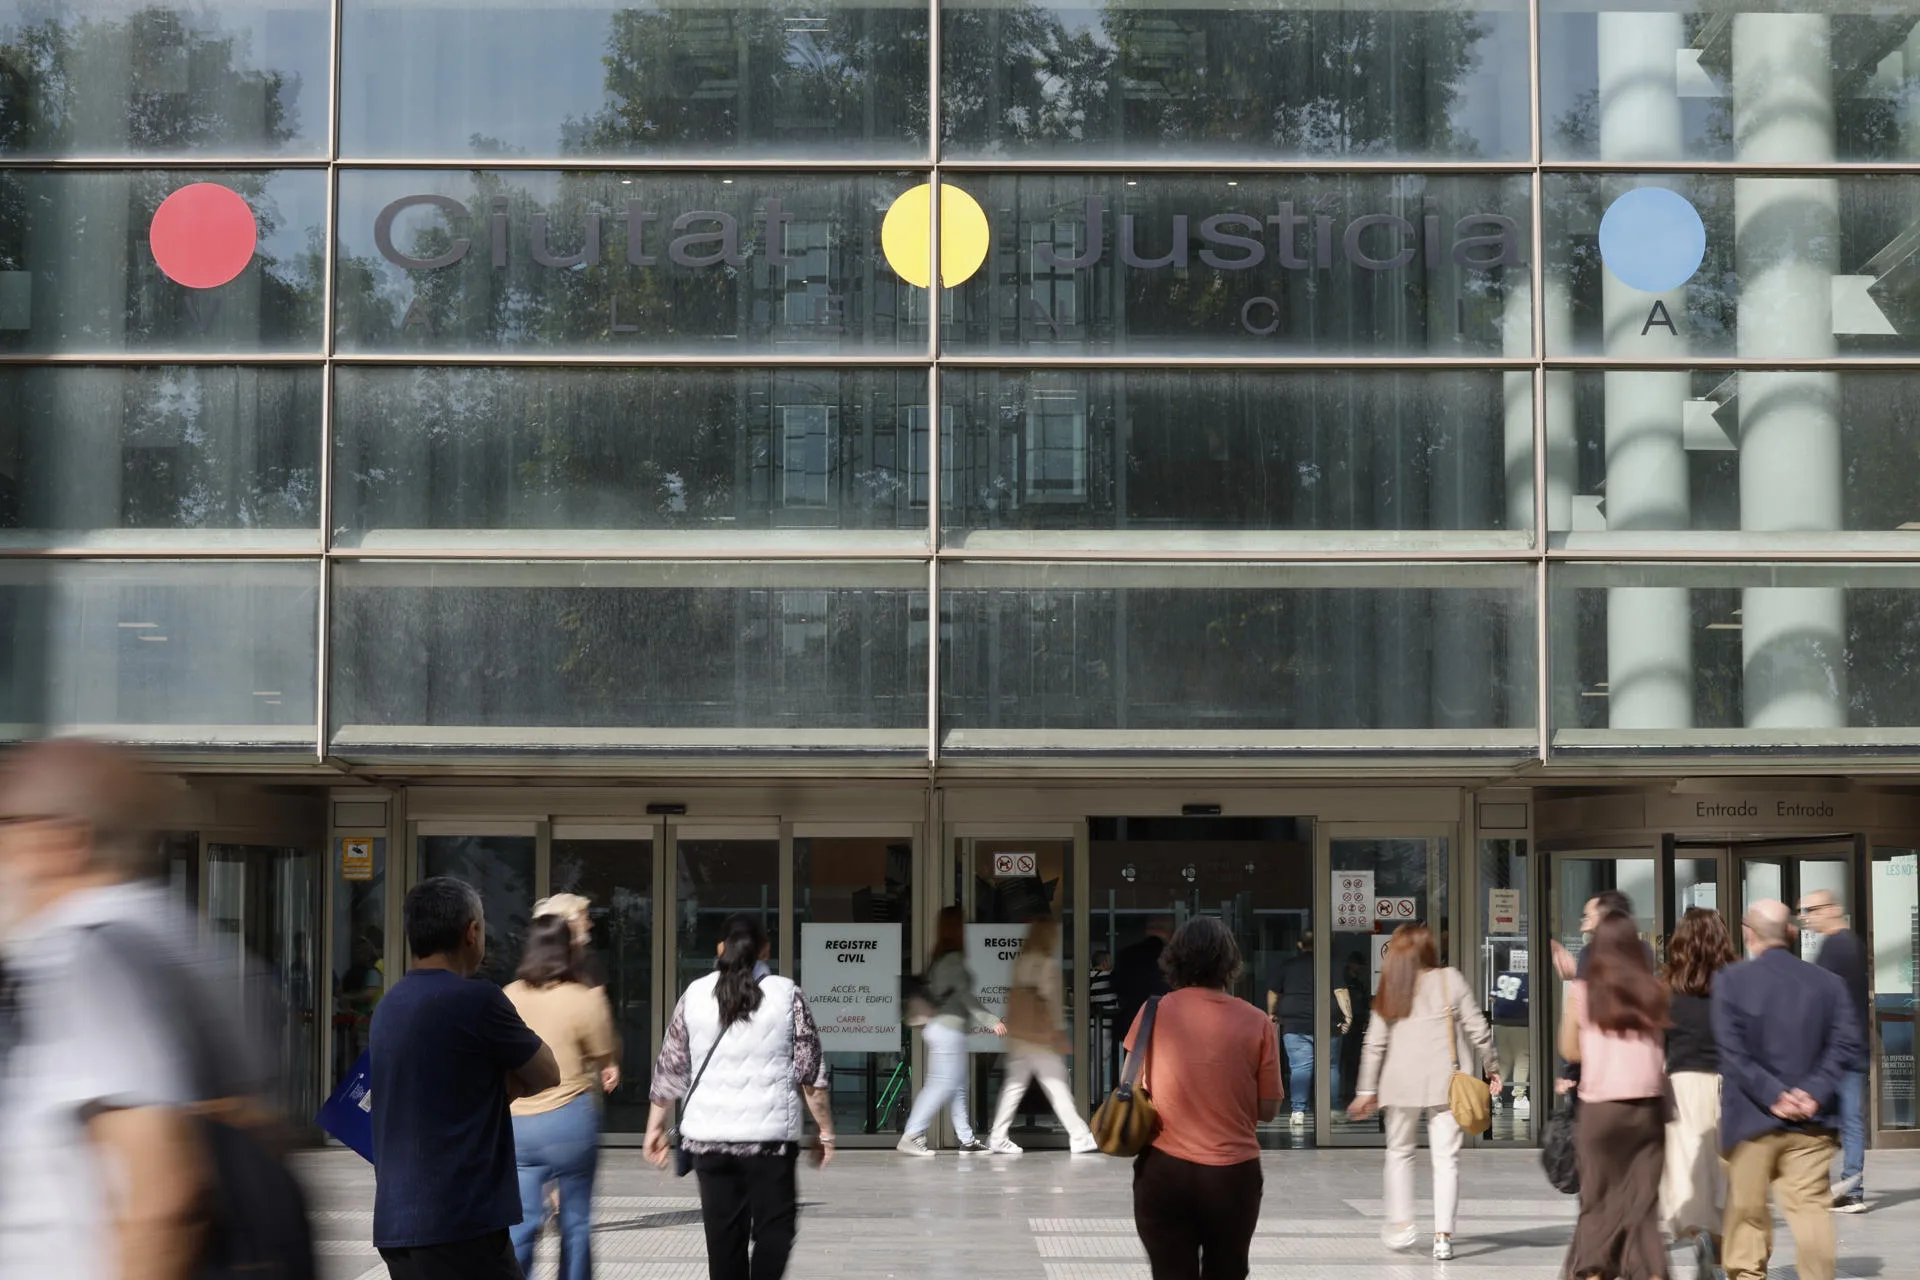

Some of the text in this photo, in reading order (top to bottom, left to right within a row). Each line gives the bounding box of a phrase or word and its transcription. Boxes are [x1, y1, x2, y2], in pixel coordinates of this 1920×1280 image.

[374, 193, 795, 269] Ciutat
[1696, 799, 1834, 817] Entrada Entrada
[825, 940, 878, 950] REGISTRE
[984, 938, 1027, 947] REGIST
[837, 953, 866, 963] CIVIL
[858, 985, 871, 993] PEL
[809, 995, 841, 1004] LATERAL
[843, 995, 854, 1004] DE
[865, 995, 893, 1004] EDIFICI
[836, 1015, 866, 1024] CARRER
